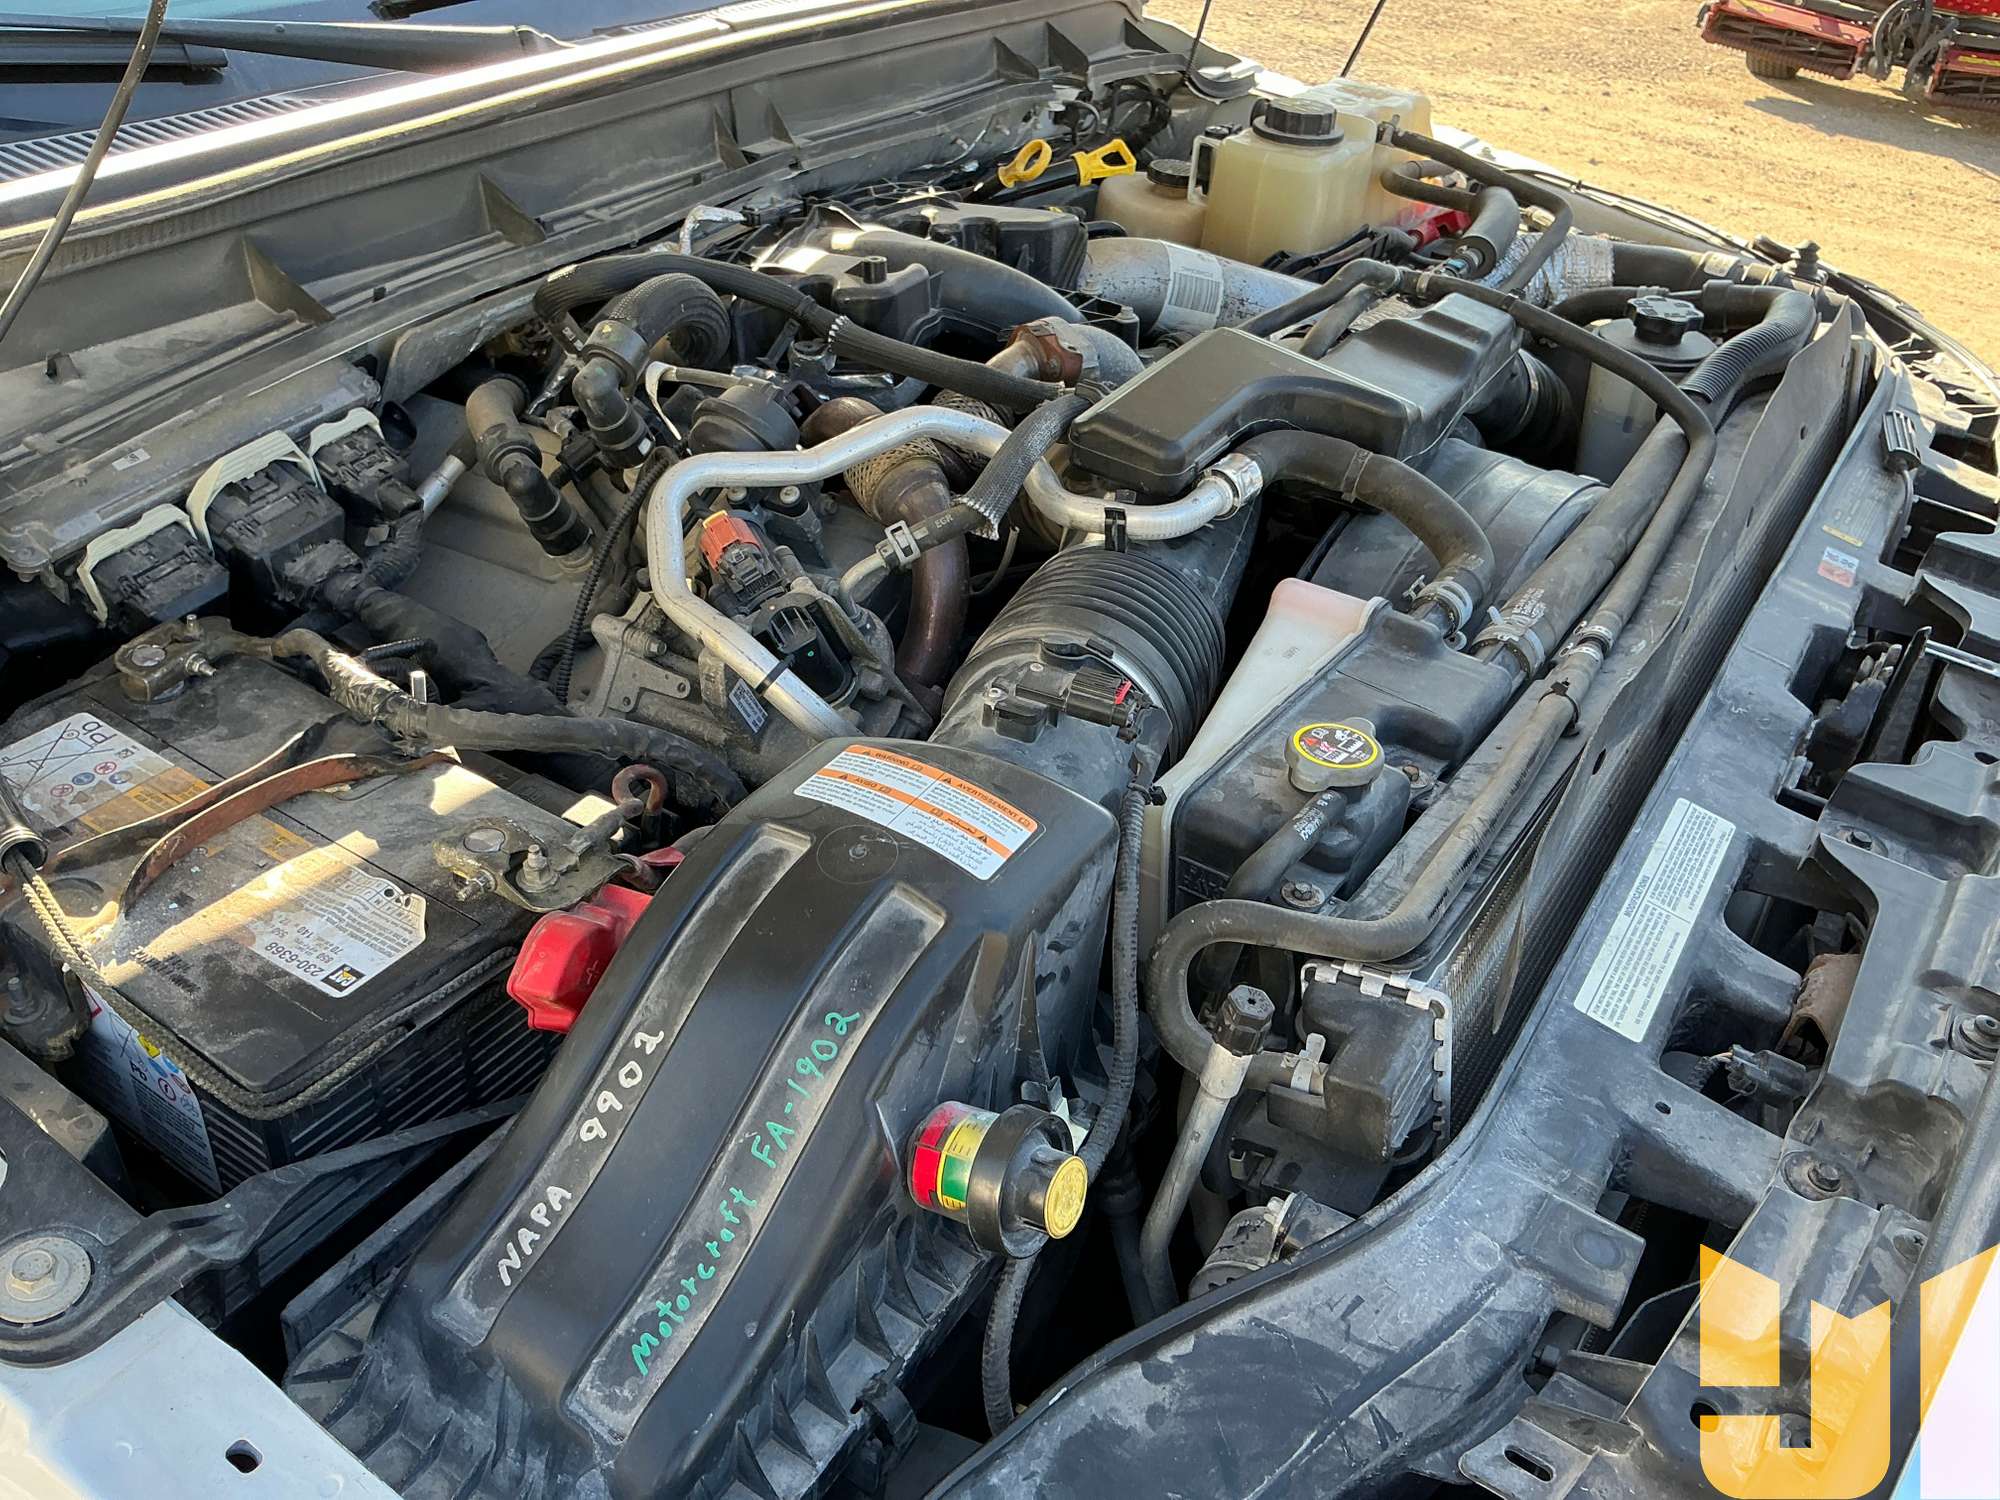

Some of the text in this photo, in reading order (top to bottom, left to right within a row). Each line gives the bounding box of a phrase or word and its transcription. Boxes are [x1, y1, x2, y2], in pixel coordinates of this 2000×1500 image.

[934, 514, 954, 528] EGR
[82, 721, 117, 746] Pb
[958, 783, 1019, 819] AVERTISSEMENT
[296, 926, 315, 939] 140
[264, 941, 357, 987] CAT 230-6368
[498, 1030, 665, 1286] NAPA 9902
[631, 1011, 861, 1376] Motorcraft FA-1902
